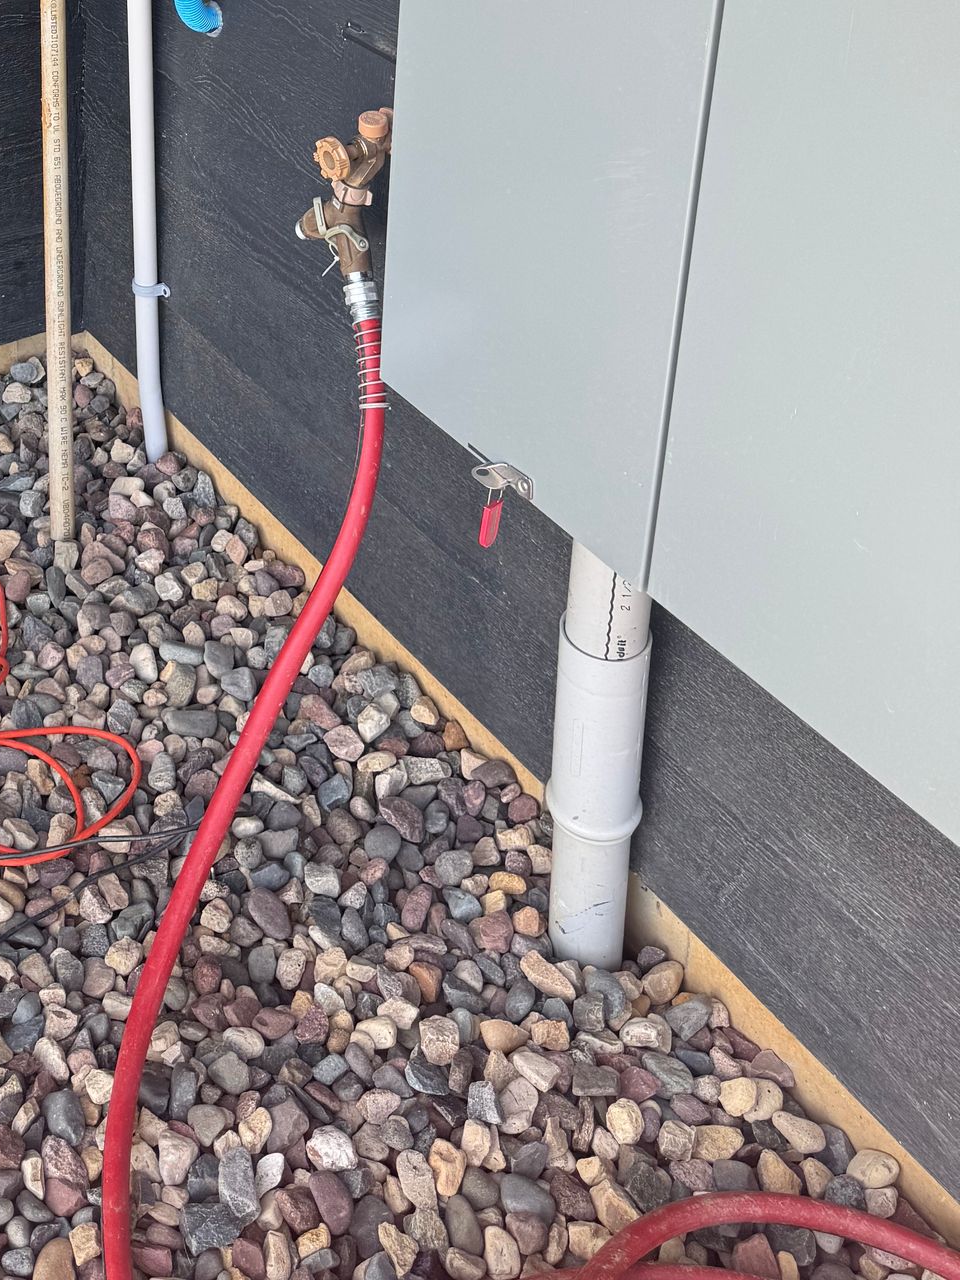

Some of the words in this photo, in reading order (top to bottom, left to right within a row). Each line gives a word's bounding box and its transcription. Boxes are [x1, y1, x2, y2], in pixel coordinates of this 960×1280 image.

[50, 10, 59, 34] LISTED
[51, 70, 60, 108] CONFORMS
[53, 138, 61, 153] STD
[53, 156, 62, 170] 651
[54, 174, 63, 225] ABOVEGROUND
[55, 228, 63, 243] AND
[55, 246, 65, 297] UNDERGROUND
[57, 300, 66, 337] SUNLIGHT
[58, 341, 67, 382] RESISTANT
[59, 386, 67, 402] MAX
[60, 426, 68, 445] WIRE
[61, 449, 69, 469] NEMA
[61, 472, 70, 492] TC-2
[620, 604, 631, 612] 2
[617, 639, 627, 661] duit
